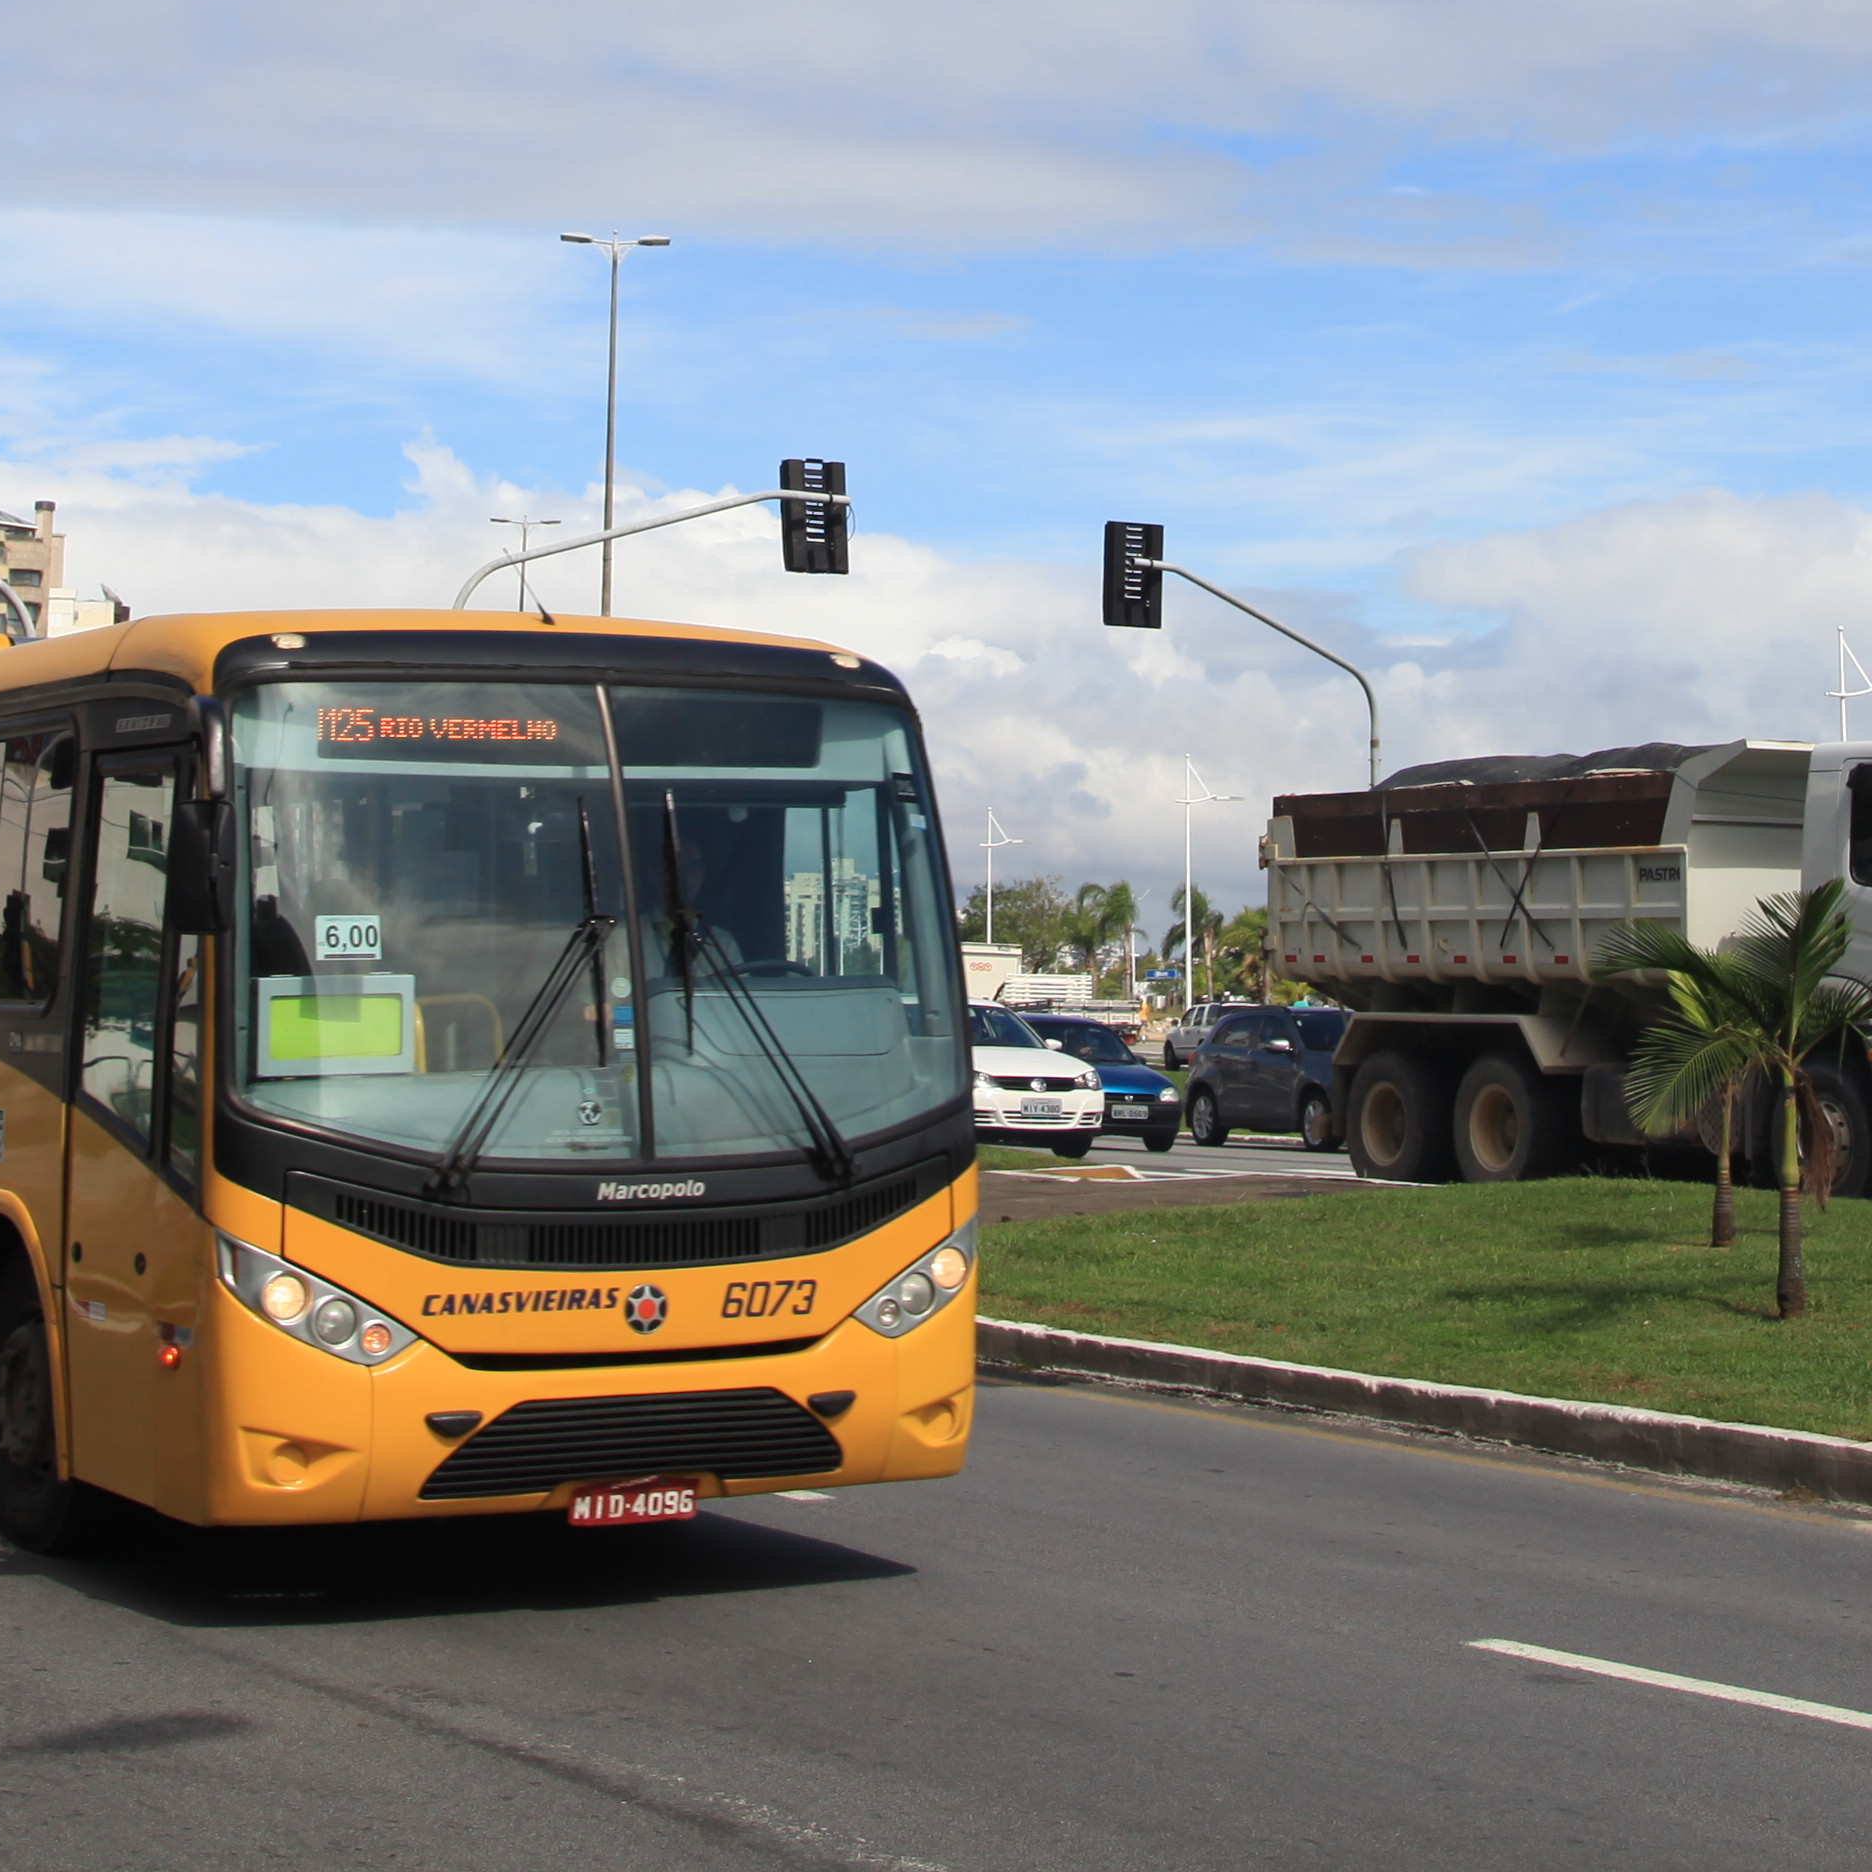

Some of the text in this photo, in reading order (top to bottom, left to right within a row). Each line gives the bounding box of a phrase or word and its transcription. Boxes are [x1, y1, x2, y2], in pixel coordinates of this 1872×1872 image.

[380, 717, 423, 738] RIO
[429, 718, 557, 740] VERMELHO
[326, 924, 378, 952] 6,00
[597, 1180, 706, 1200] Marcopolo
[421, 1279, 817, 1319] CANASVIEIRAS 6073
